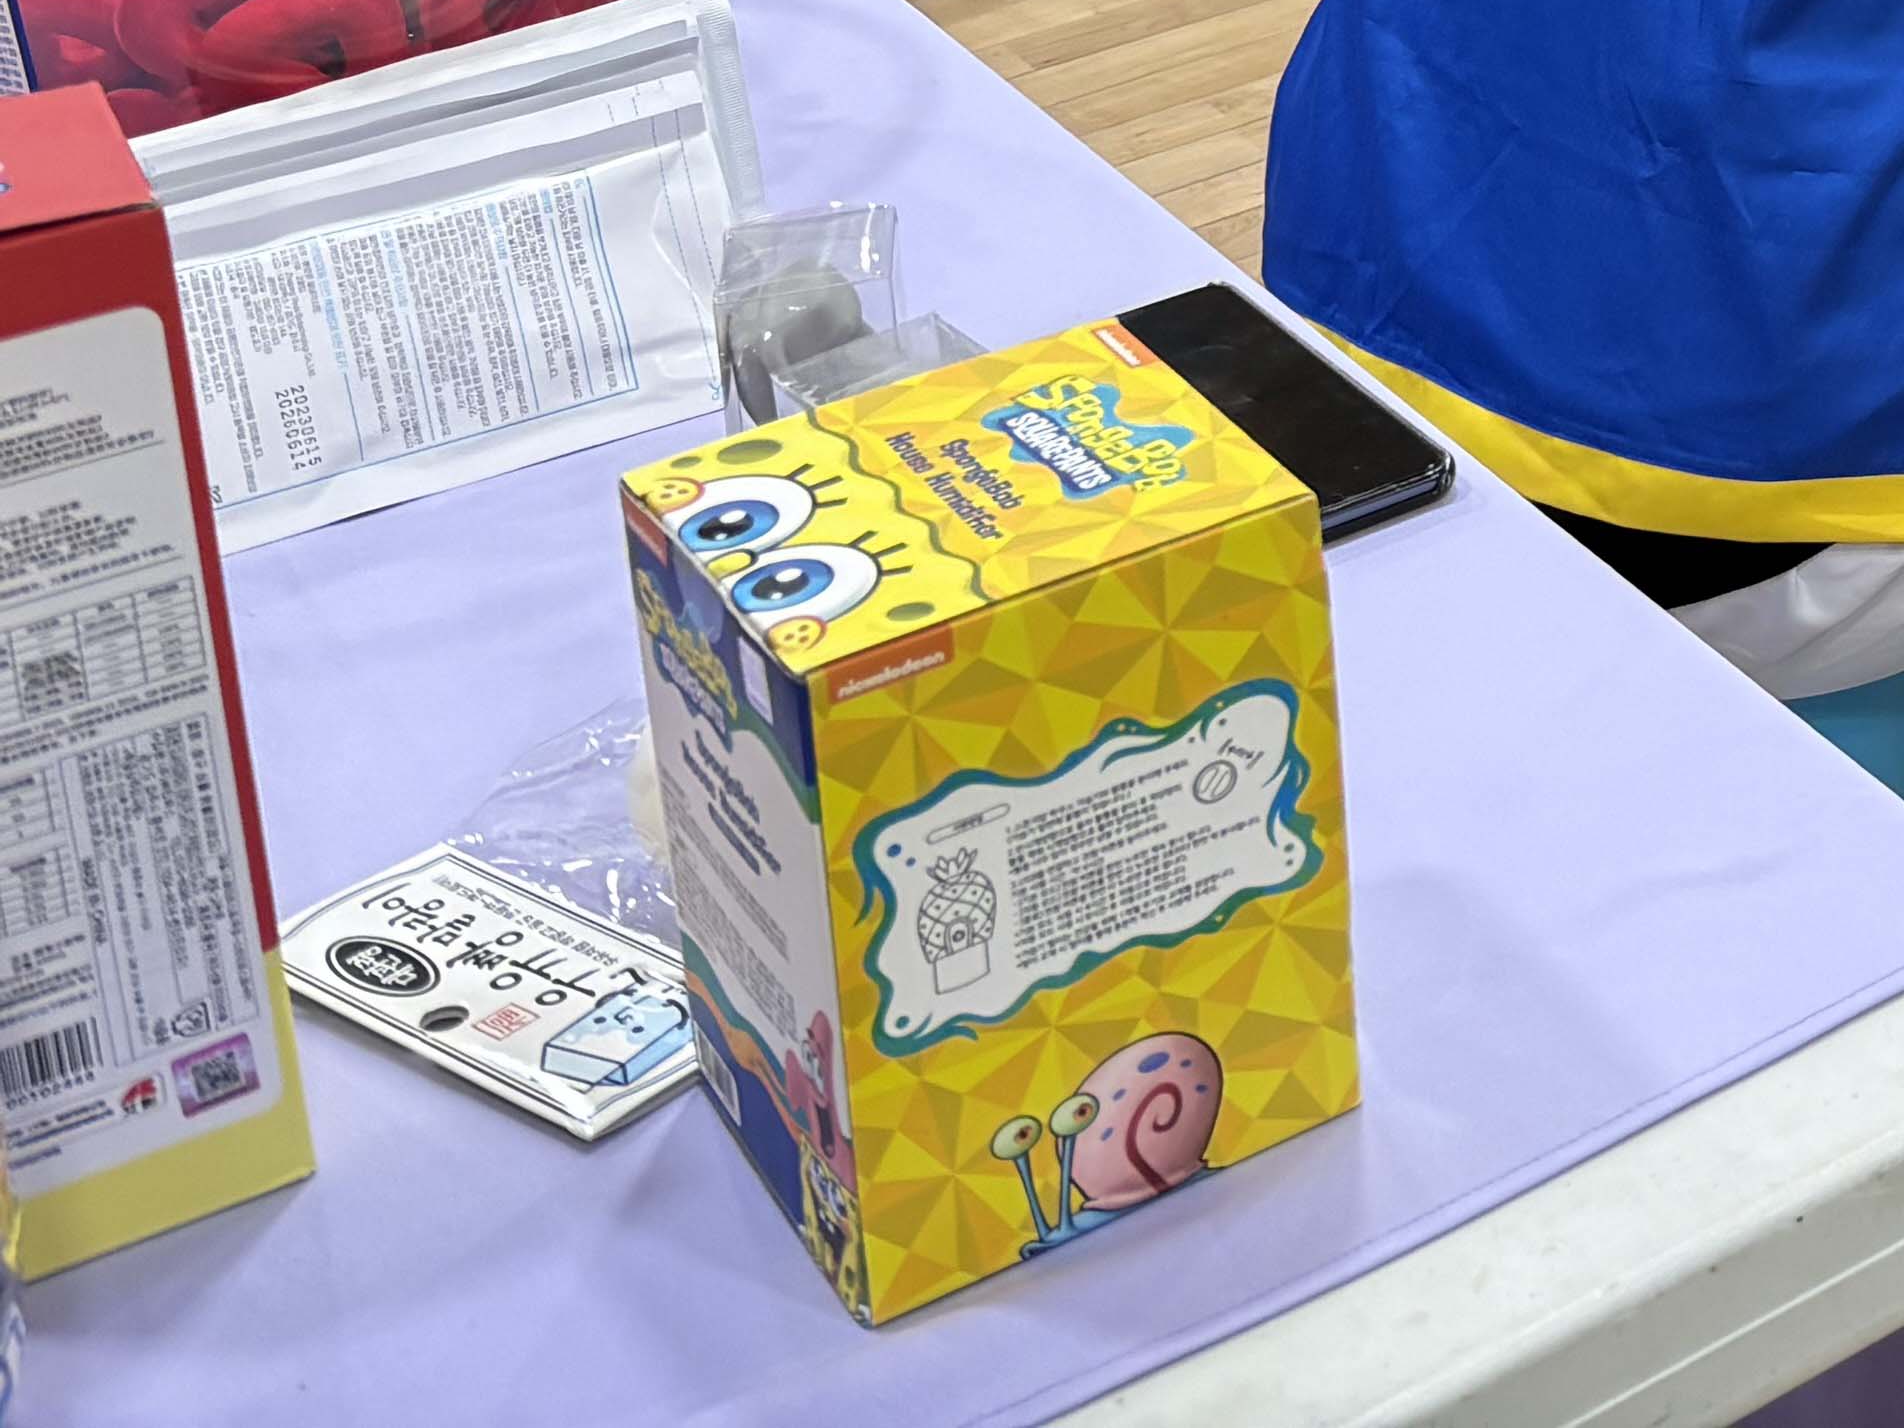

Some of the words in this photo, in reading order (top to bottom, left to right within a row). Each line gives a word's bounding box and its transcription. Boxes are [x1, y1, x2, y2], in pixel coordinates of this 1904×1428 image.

[274, 387, 308, 472] 20260614
[289, 382, 322, 468] 20230615
[1007, 410, 1115, 491] SQUAREPANTS
[886, 432, 935, 472] House
[930, 468, 1004, 541] Humidifier
[941, 438, 1022, 512] SpongeBob
[836, 647, 945, 699] nickelodeon
[362, 883, 476, 947] 말랑이
[348, 947, 419, 991] 대관령
